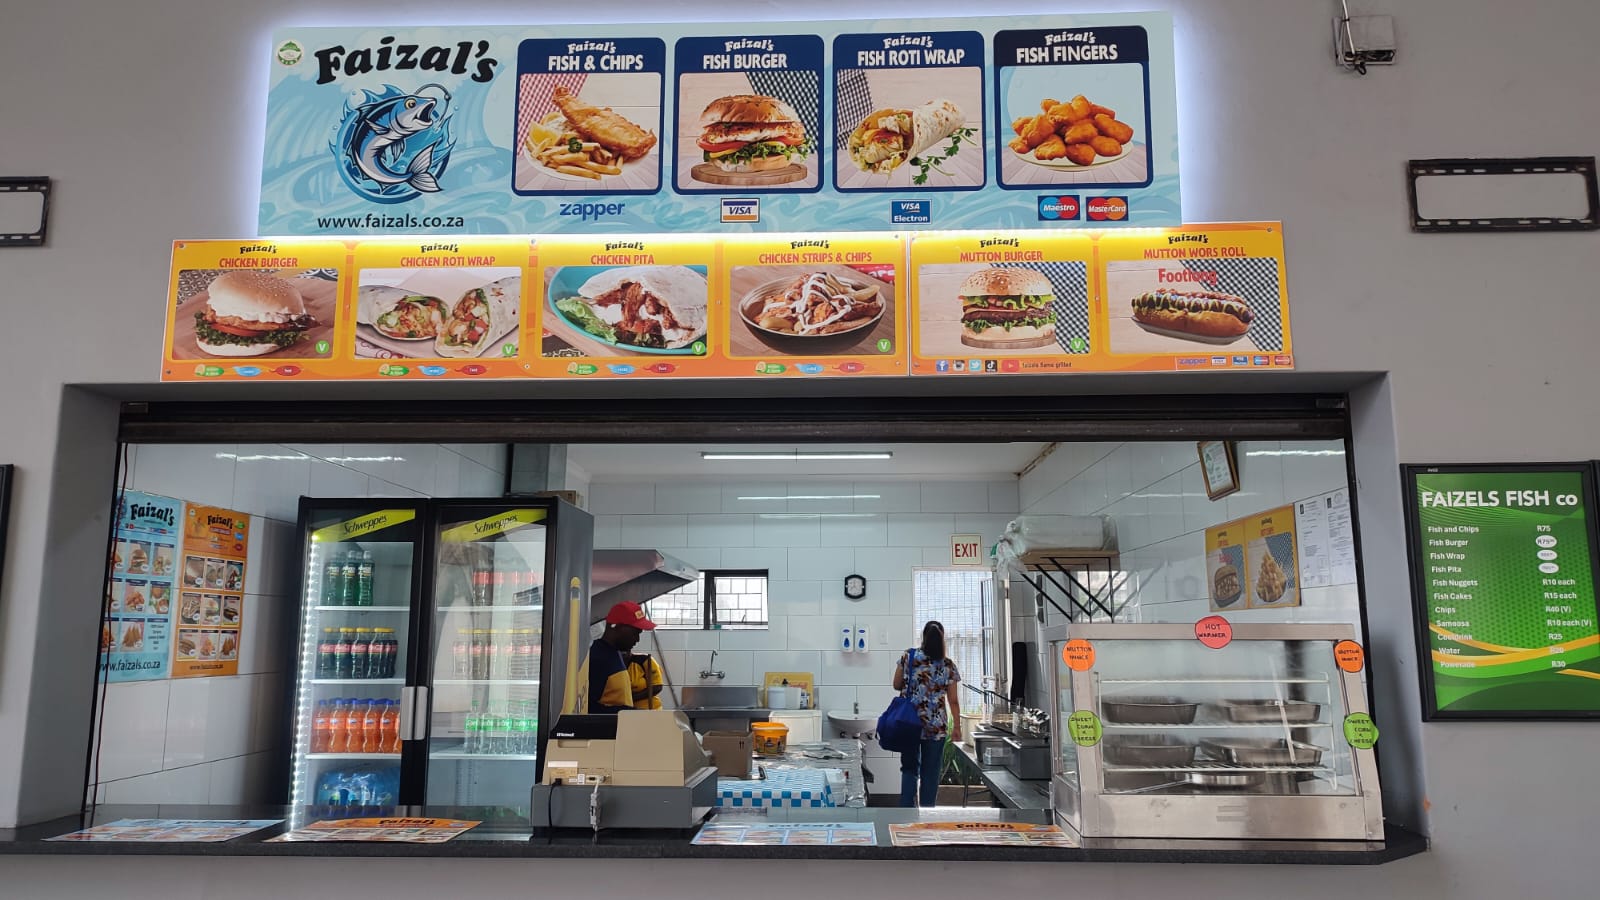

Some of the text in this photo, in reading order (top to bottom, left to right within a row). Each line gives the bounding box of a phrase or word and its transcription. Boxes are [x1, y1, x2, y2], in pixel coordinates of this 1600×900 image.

[884, 34, 933, 49] Faizal's
[1045, 31, 1095, 46] Faizal's
[568, 41, 616, 54] Faizal's
[725, 38, 773, 52] Faizal's
[858, 49, 964, 66] FISH ROTI WRAP
[1016, 45, 1118, 63] FISH FINGERS
[314, 36, 498, 84] Faizal's
[548, 54, 643, 71] FISH & CHIPS
[703, 53, 787, 70] FISH BURGER
[560, 202, 625, 220] zapper
[728, 206, 752, 215] VISA
[900, 202, 920, 211] VISA
[1044, 204, 1076, 212] Maestro
[1088, 204, 1127, 214] MasterCard
[318, 214, 464, 228] www.faizals.co.za
[894, 214, 928, 223] Electron
[791, 239, 829, 249] Faizal's
[980, 238, 1019, 248] Faizal's
[1168, 234, 1208, 244] Faizal's
[240, 244, 278, 254] Faizal's
[420, 243, 459, 253] Faizal's
[605, 241, 644, 251] Faizal's
[960, 251, 1043, 262] MUTTON BURGER
[1144, 246, 1246, 259] MUTTON WORS ROLL
[219, 257, 298, 267] CHICKEN BURGER
[401, 256, 495, 267] CHICKEN ROTI WRAP
[591, 254, 654, 265] CHICKEN PITA
[759, 252, 872, 264] CHICKEN STRIPS & CHIPS
[1158, 269, 1217, 286] Footlong
[319, 342, 325, 351] V
[695, 344, 702, 352] V
[881, 341, 888, 350] V
[1074, 341, 1082, 350] V
[1422, 490, 1500, 508] FAIZELS
[1506, 490, 1549, 506] FISH
[130, 502, 175, 526] Faizal's
[1458, 526, 1479, 535] Chips
[1445, 539, 1468, 548] Burger
[954, 544, 978, 557] EXIT
[1446, 553, 1465, 561] Wrap
[1449, 579, 1478, 588] Nuggets
[1435, 606, 1456, 615] Chips
[1205, 623, 1221, 631] HOT
